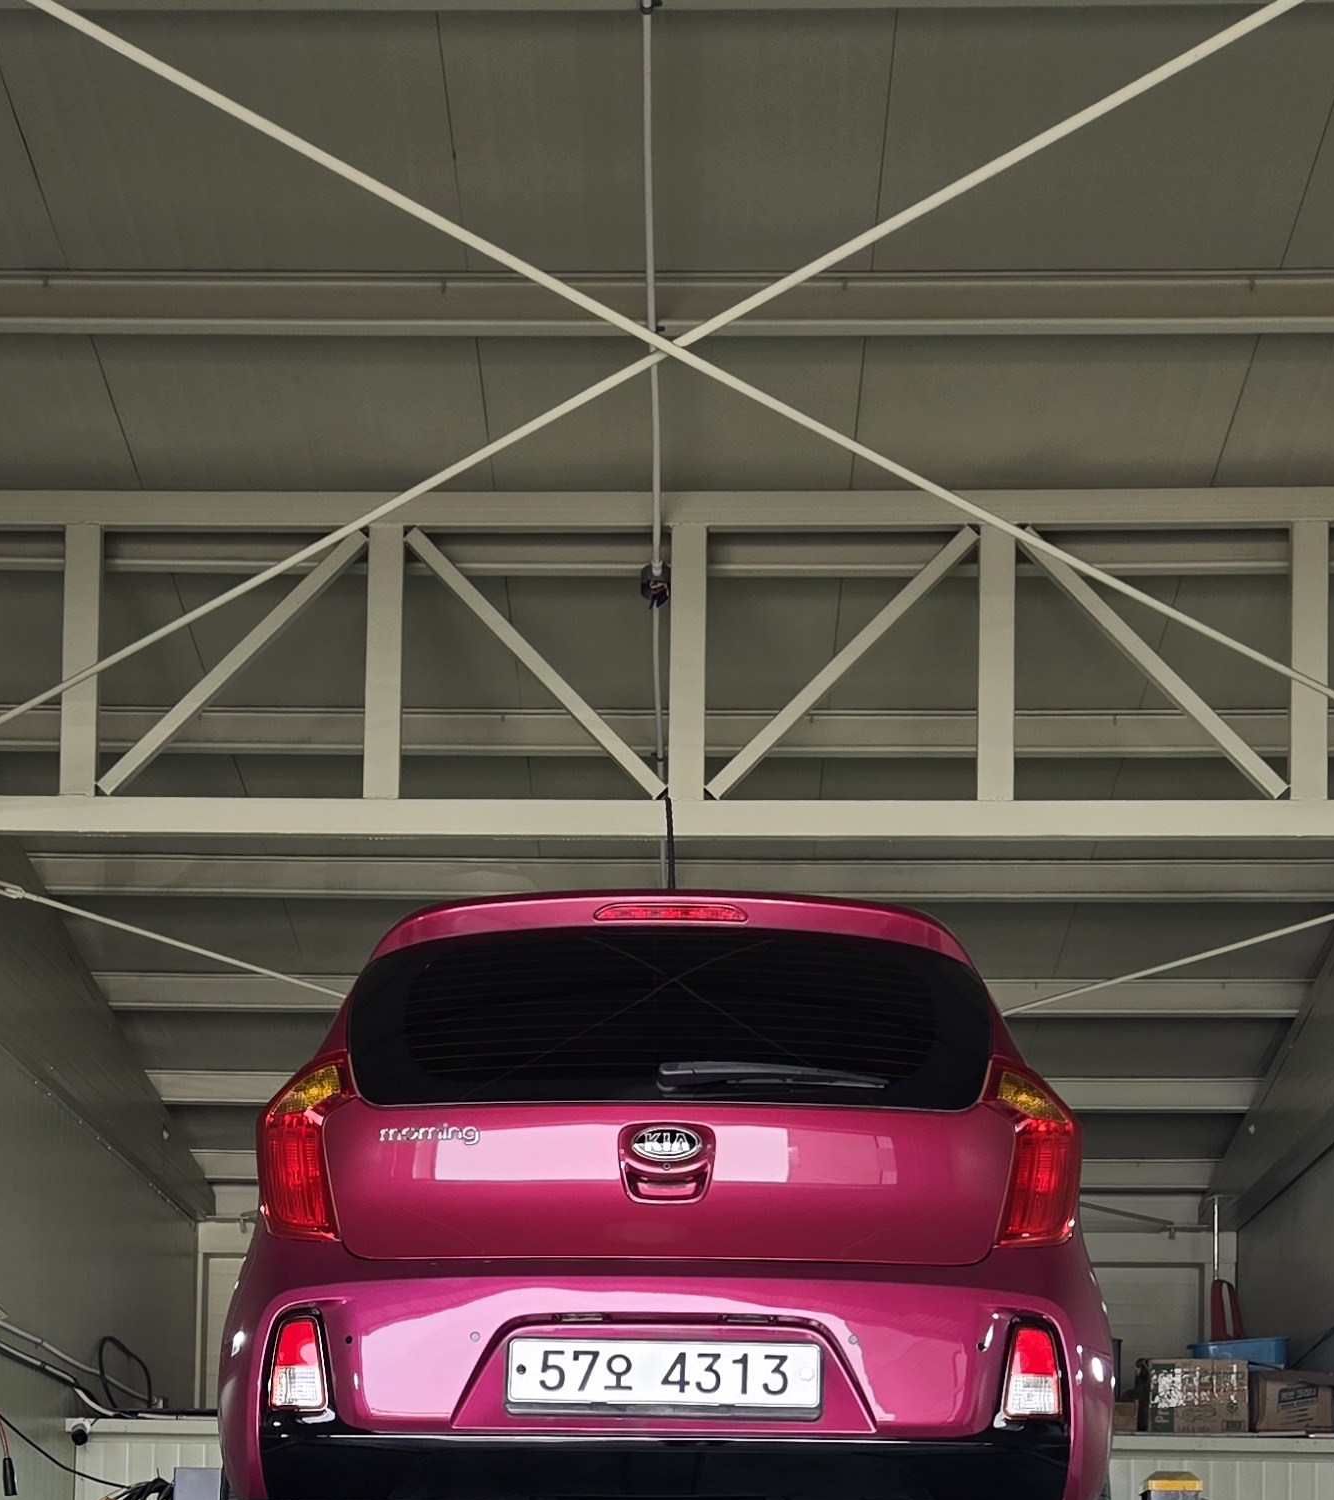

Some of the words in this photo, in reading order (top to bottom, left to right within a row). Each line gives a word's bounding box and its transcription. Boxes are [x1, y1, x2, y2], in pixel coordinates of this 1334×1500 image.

[379, 1123, 480, 1146] morning
[644, 1132, 691, 1152] KIA
[539, 1350, 633, 1392] 57오
[661, 1352, 789, 1396] 4313
